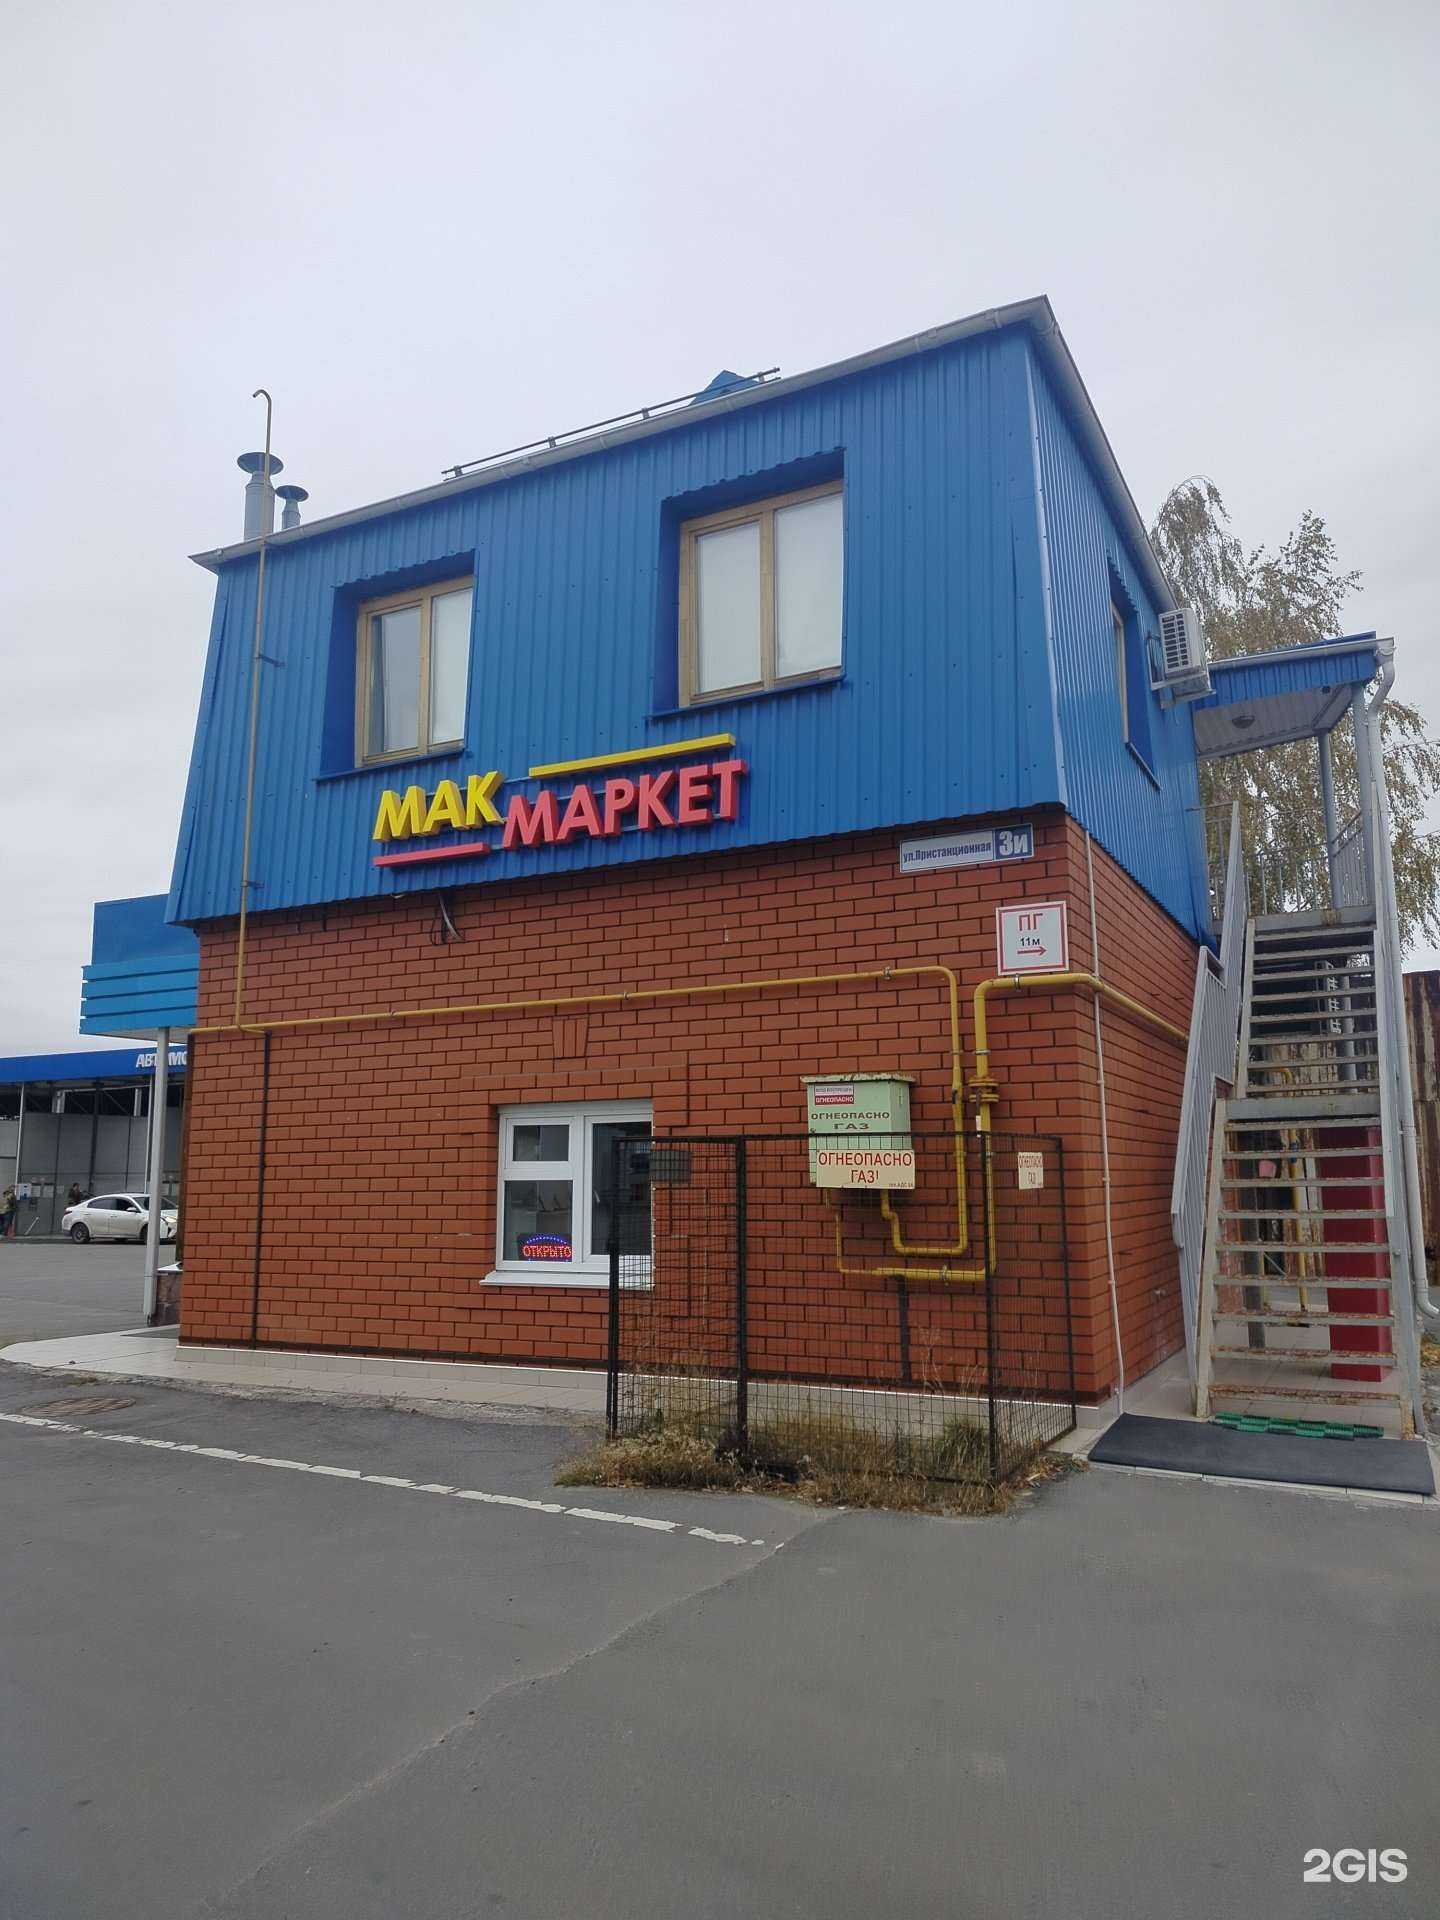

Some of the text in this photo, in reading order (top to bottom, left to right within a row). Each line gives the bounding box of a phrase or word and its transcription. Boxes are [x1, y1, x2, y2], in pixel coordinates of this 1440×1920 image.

[372, 759, 747, 850] МАК МАРКЕТ
[1018, 913, 1043, 931] ПГ
[1019, 936, 1041, 947] 11м
[811, 1111, 890, 1120] ОГНЕОПАСНО
[833, 1122, 870, 1130] ГАЗ
[818, 1152, 912, 1166] ОГНЕОПАСНО
[523, 1245, 571, 1257] ОТКРЫТО
